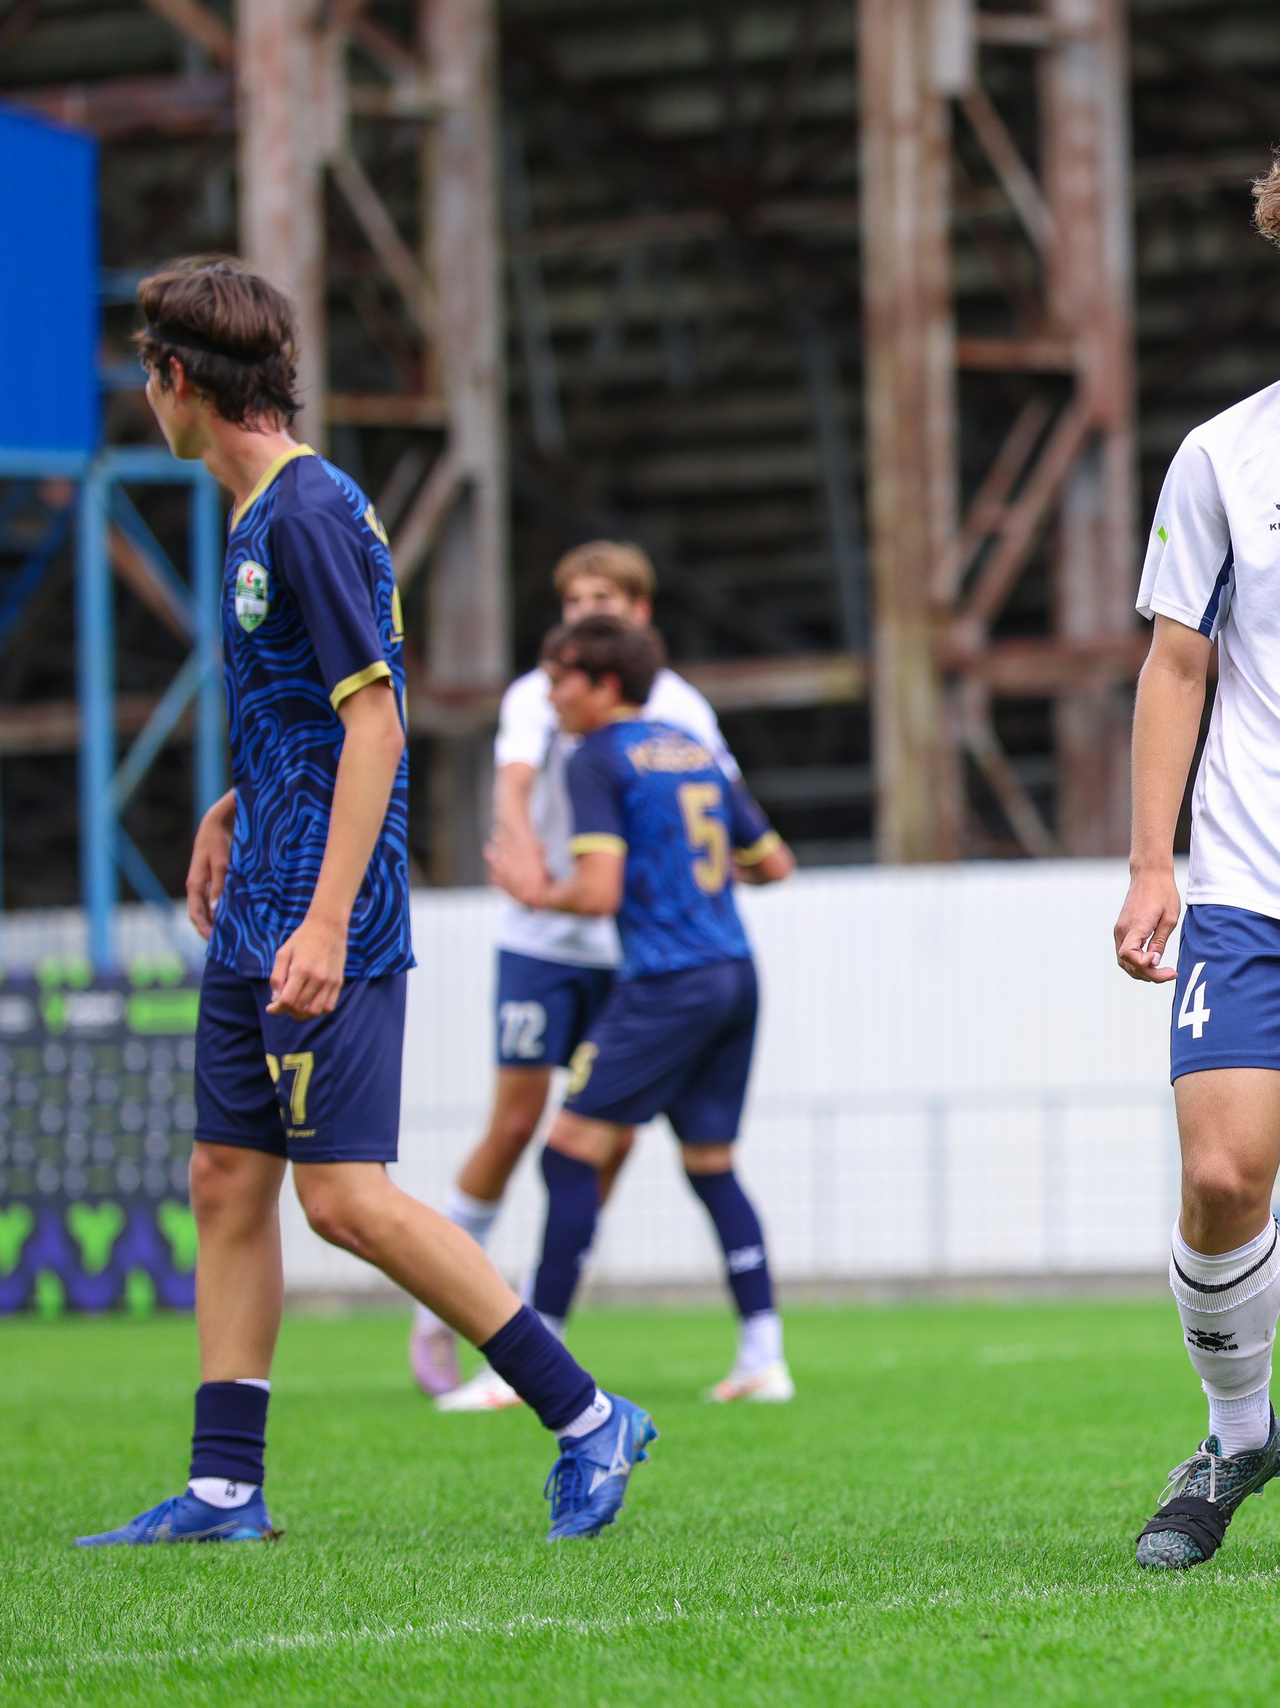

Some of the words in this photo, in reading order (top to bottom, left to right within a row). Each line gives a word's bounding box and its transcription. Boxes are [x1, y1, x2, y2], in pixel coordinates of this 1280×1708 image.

[677, 781, 729, 896] 5
[1177, 961, 1211, 1039] 4
[1187, 1336, 1239, 1353] KELME
